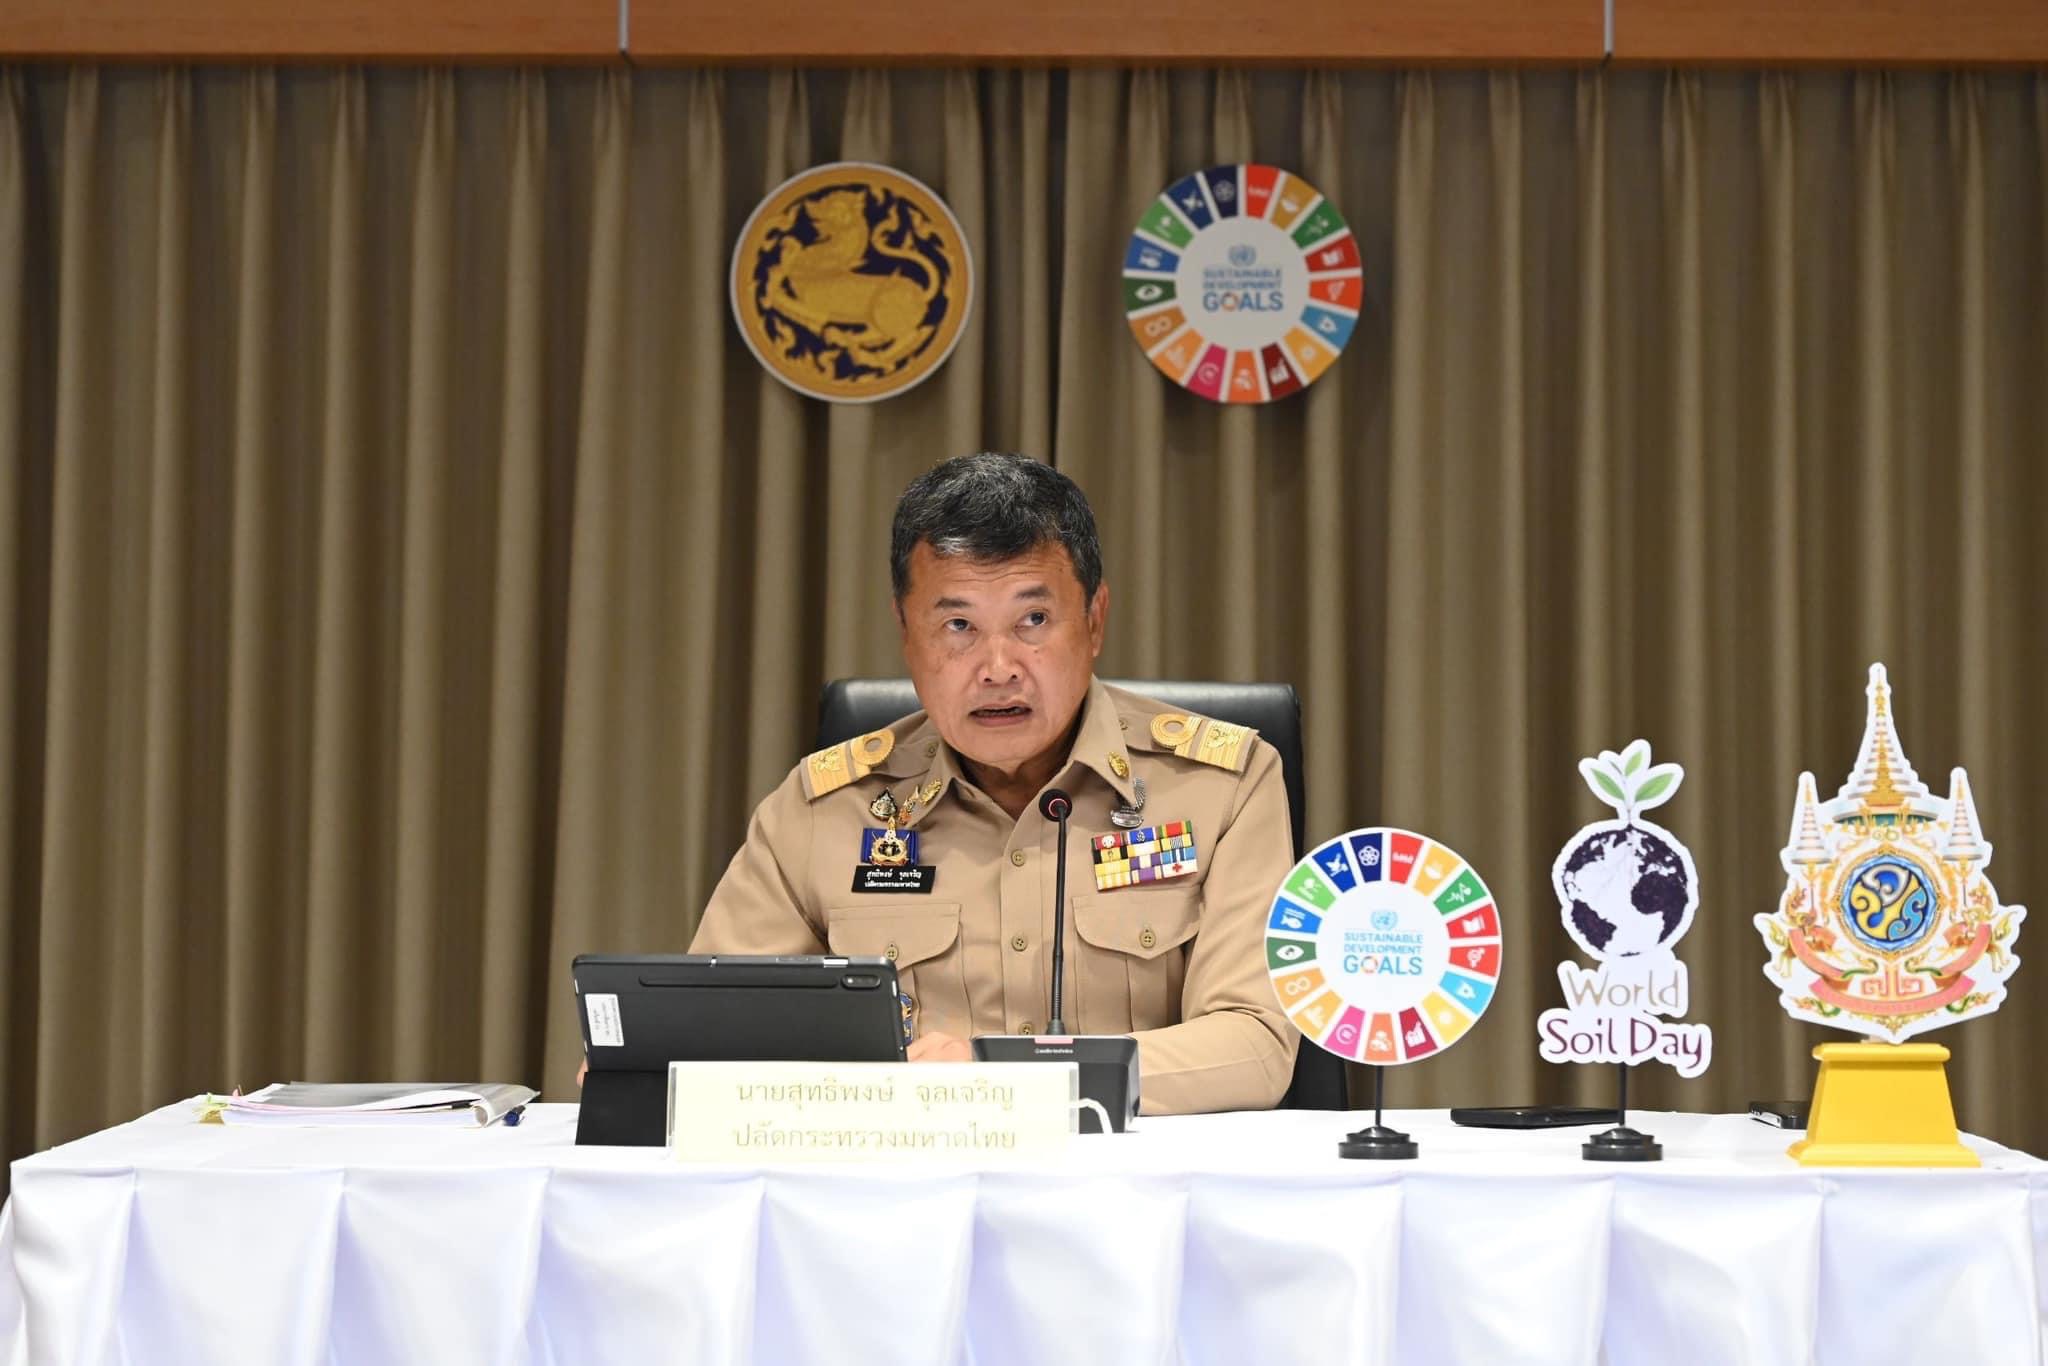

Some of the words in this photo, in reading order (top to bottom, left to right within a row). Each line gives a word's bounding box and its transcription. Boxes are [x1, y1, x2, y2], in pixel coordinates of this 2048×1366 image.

[1203, 291, 1283, 312] GOALS
[1343, 932, 1424, 944] SUSTAINABLE
[1343, 944, 1424, 955] DEVELOPMENT
[1343, 955, 1424, 975] GOALS
[1566, 970, 1679, 1008] World
[1546, 1018, 1618, 1055] Soil
[1630, 1017, 1702, 1070] Day
[736, 1076, 894, 1111] นายสุทธิพงษ์
[915, 1077, 1014, 1112] จุลเจริญ
[733, 1120, 1016, 1149] ปลัดกระทรวงมหาดไทย
